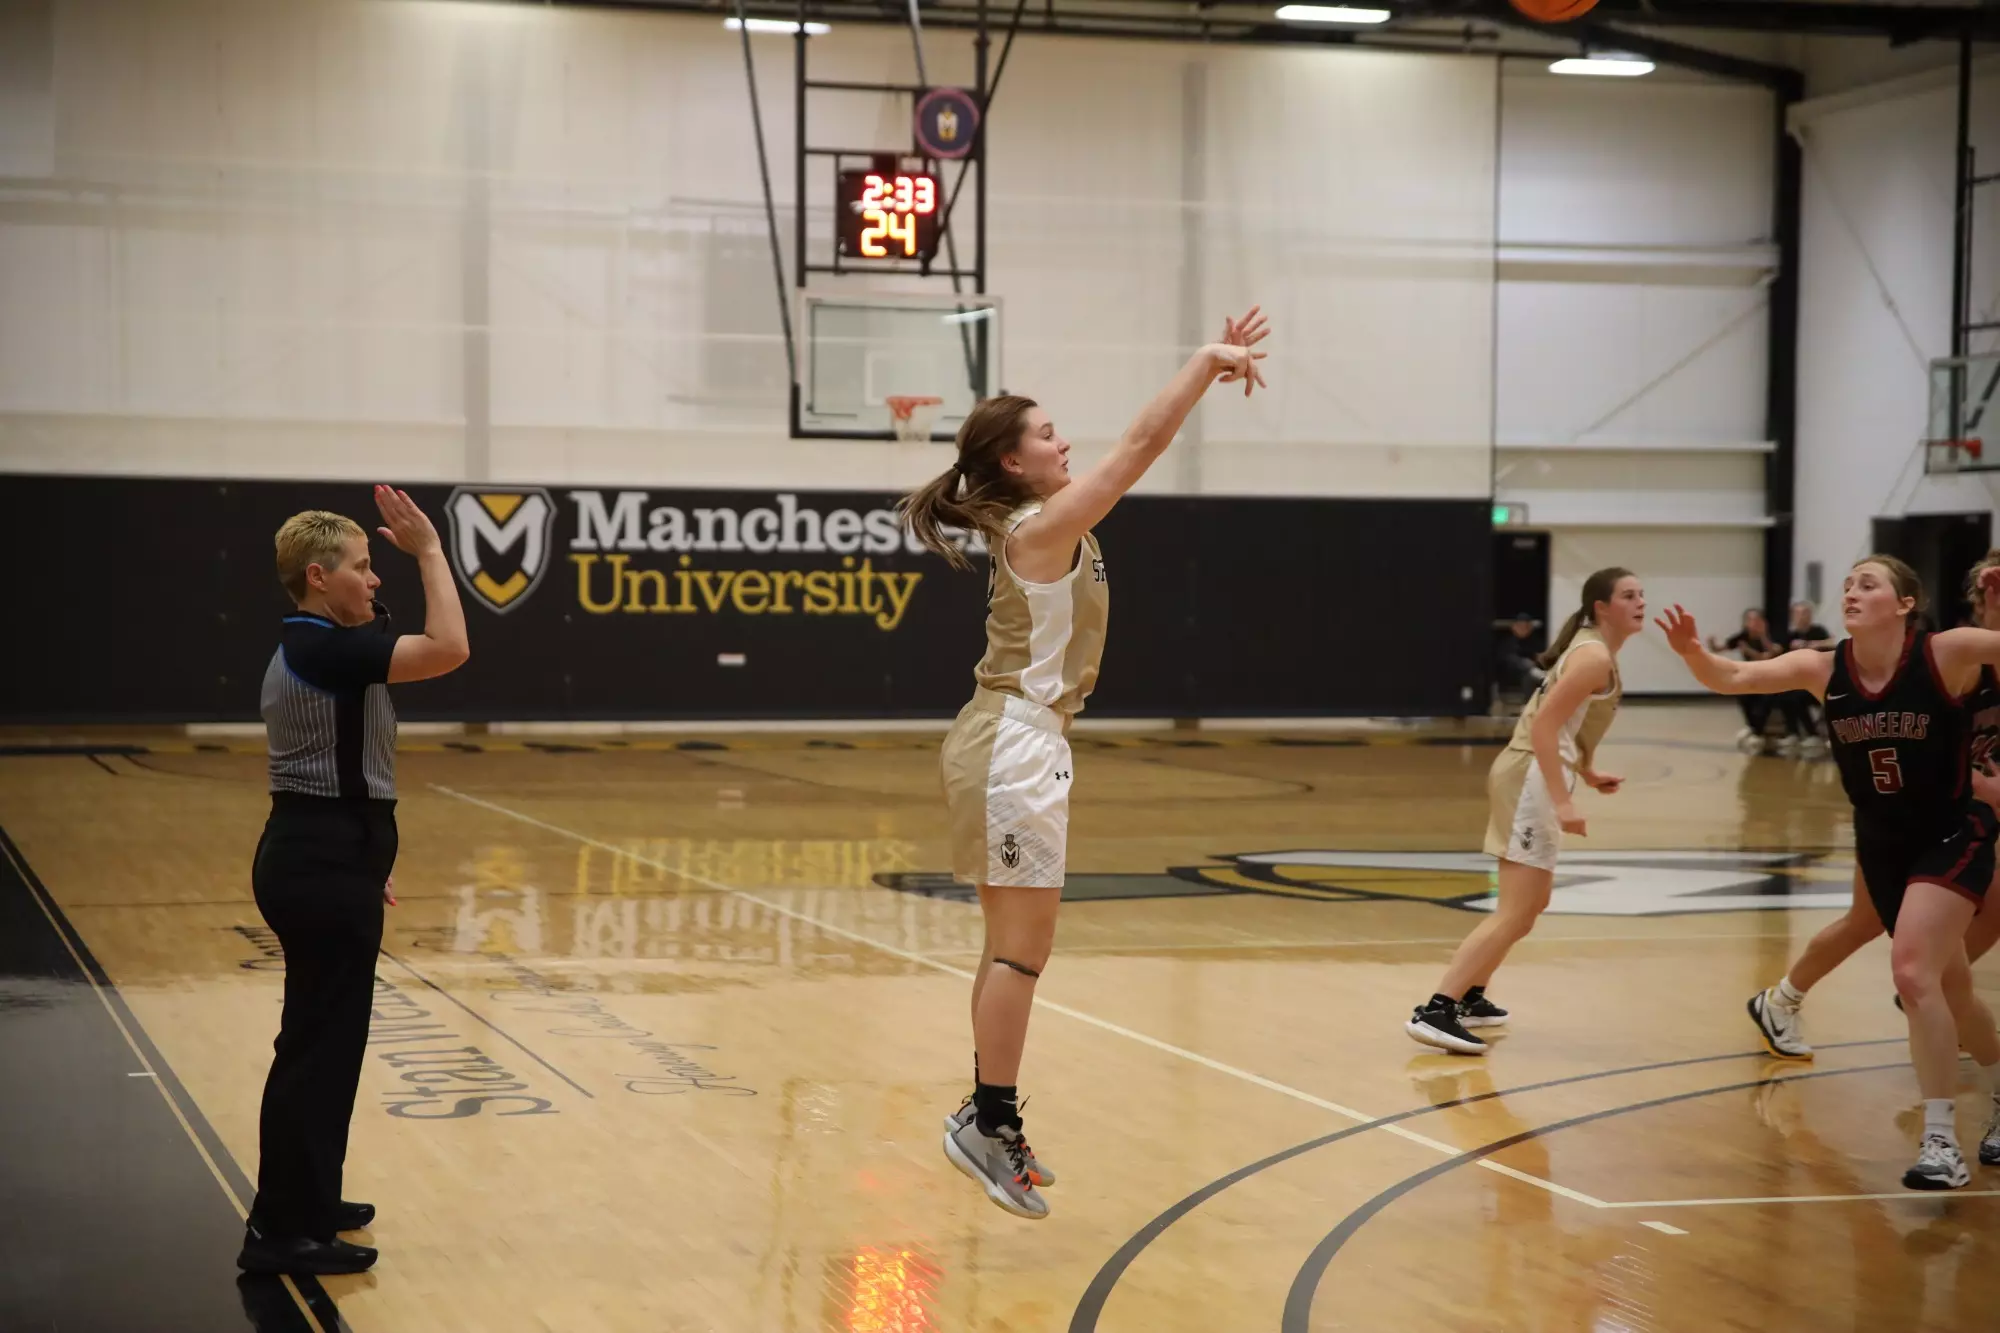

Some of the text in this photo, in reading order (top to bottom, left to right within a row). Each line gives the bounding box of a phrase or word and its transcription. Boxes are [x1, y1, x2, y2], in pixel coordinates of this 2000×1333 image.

[863, 175, 935, 213] 2:33
[861, 209, 916, 257] 24
[568, 553, 924, 631] University
[1867, 747, 1904, 794] 5
